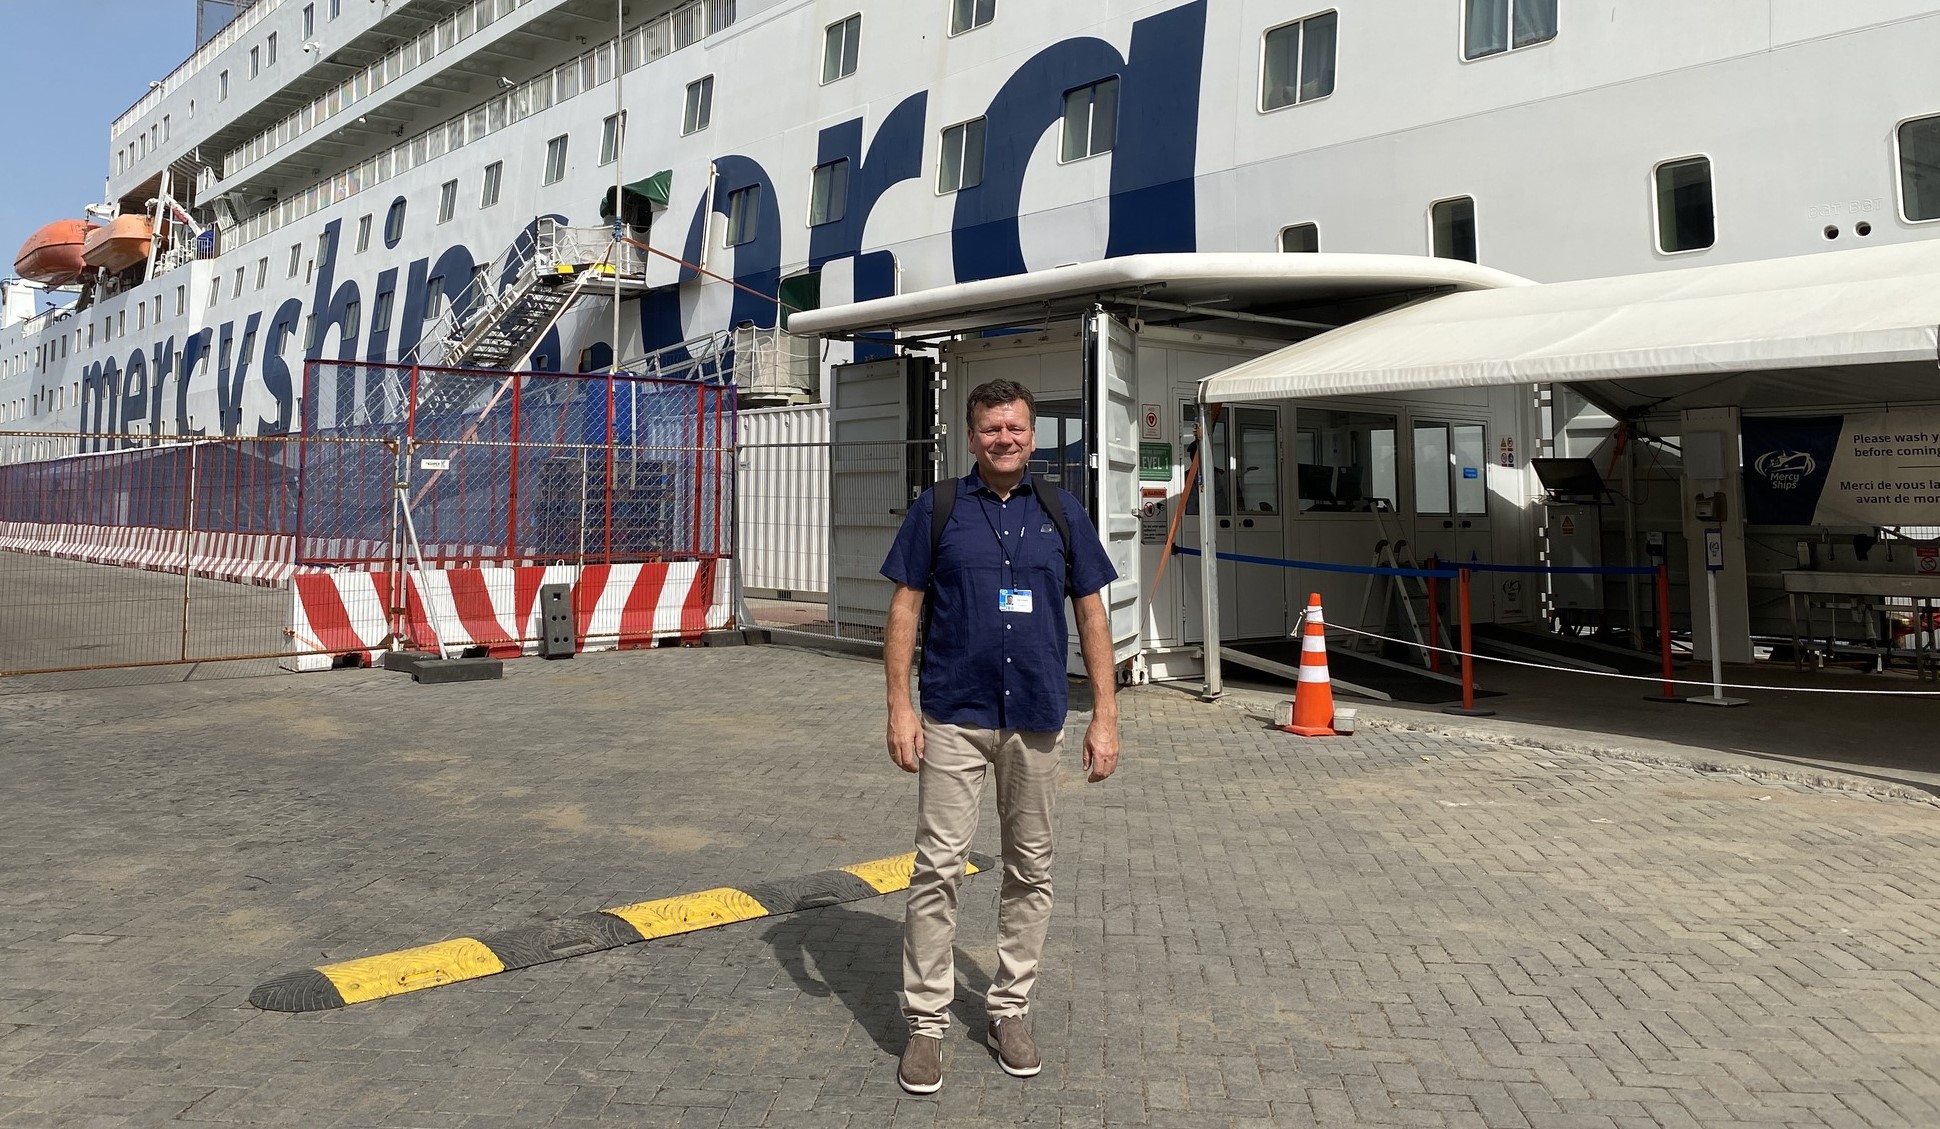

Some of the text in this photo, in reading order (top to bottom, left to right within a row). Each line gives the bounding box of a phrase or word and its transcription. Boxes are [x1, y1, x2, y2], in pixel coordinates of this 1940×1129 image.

[1853, 433, 1891, 444] Please
[1895, 432, 1928, 443] wash
[1855, 447, 1893, 457] before
[1139, 456, 1169, 470] EVEL 1
[1770, 472, 1799, 482] Mercy
[1772, 481, 1797, 490] Ships
[1840, 480, 1874, 490] Merci
[1877, 480, 1892, 490] de
[1895, 481, 1926, 490] vous
[1856, 494, 1891, 504] avant
[1894, 493, 1910, 504] de
